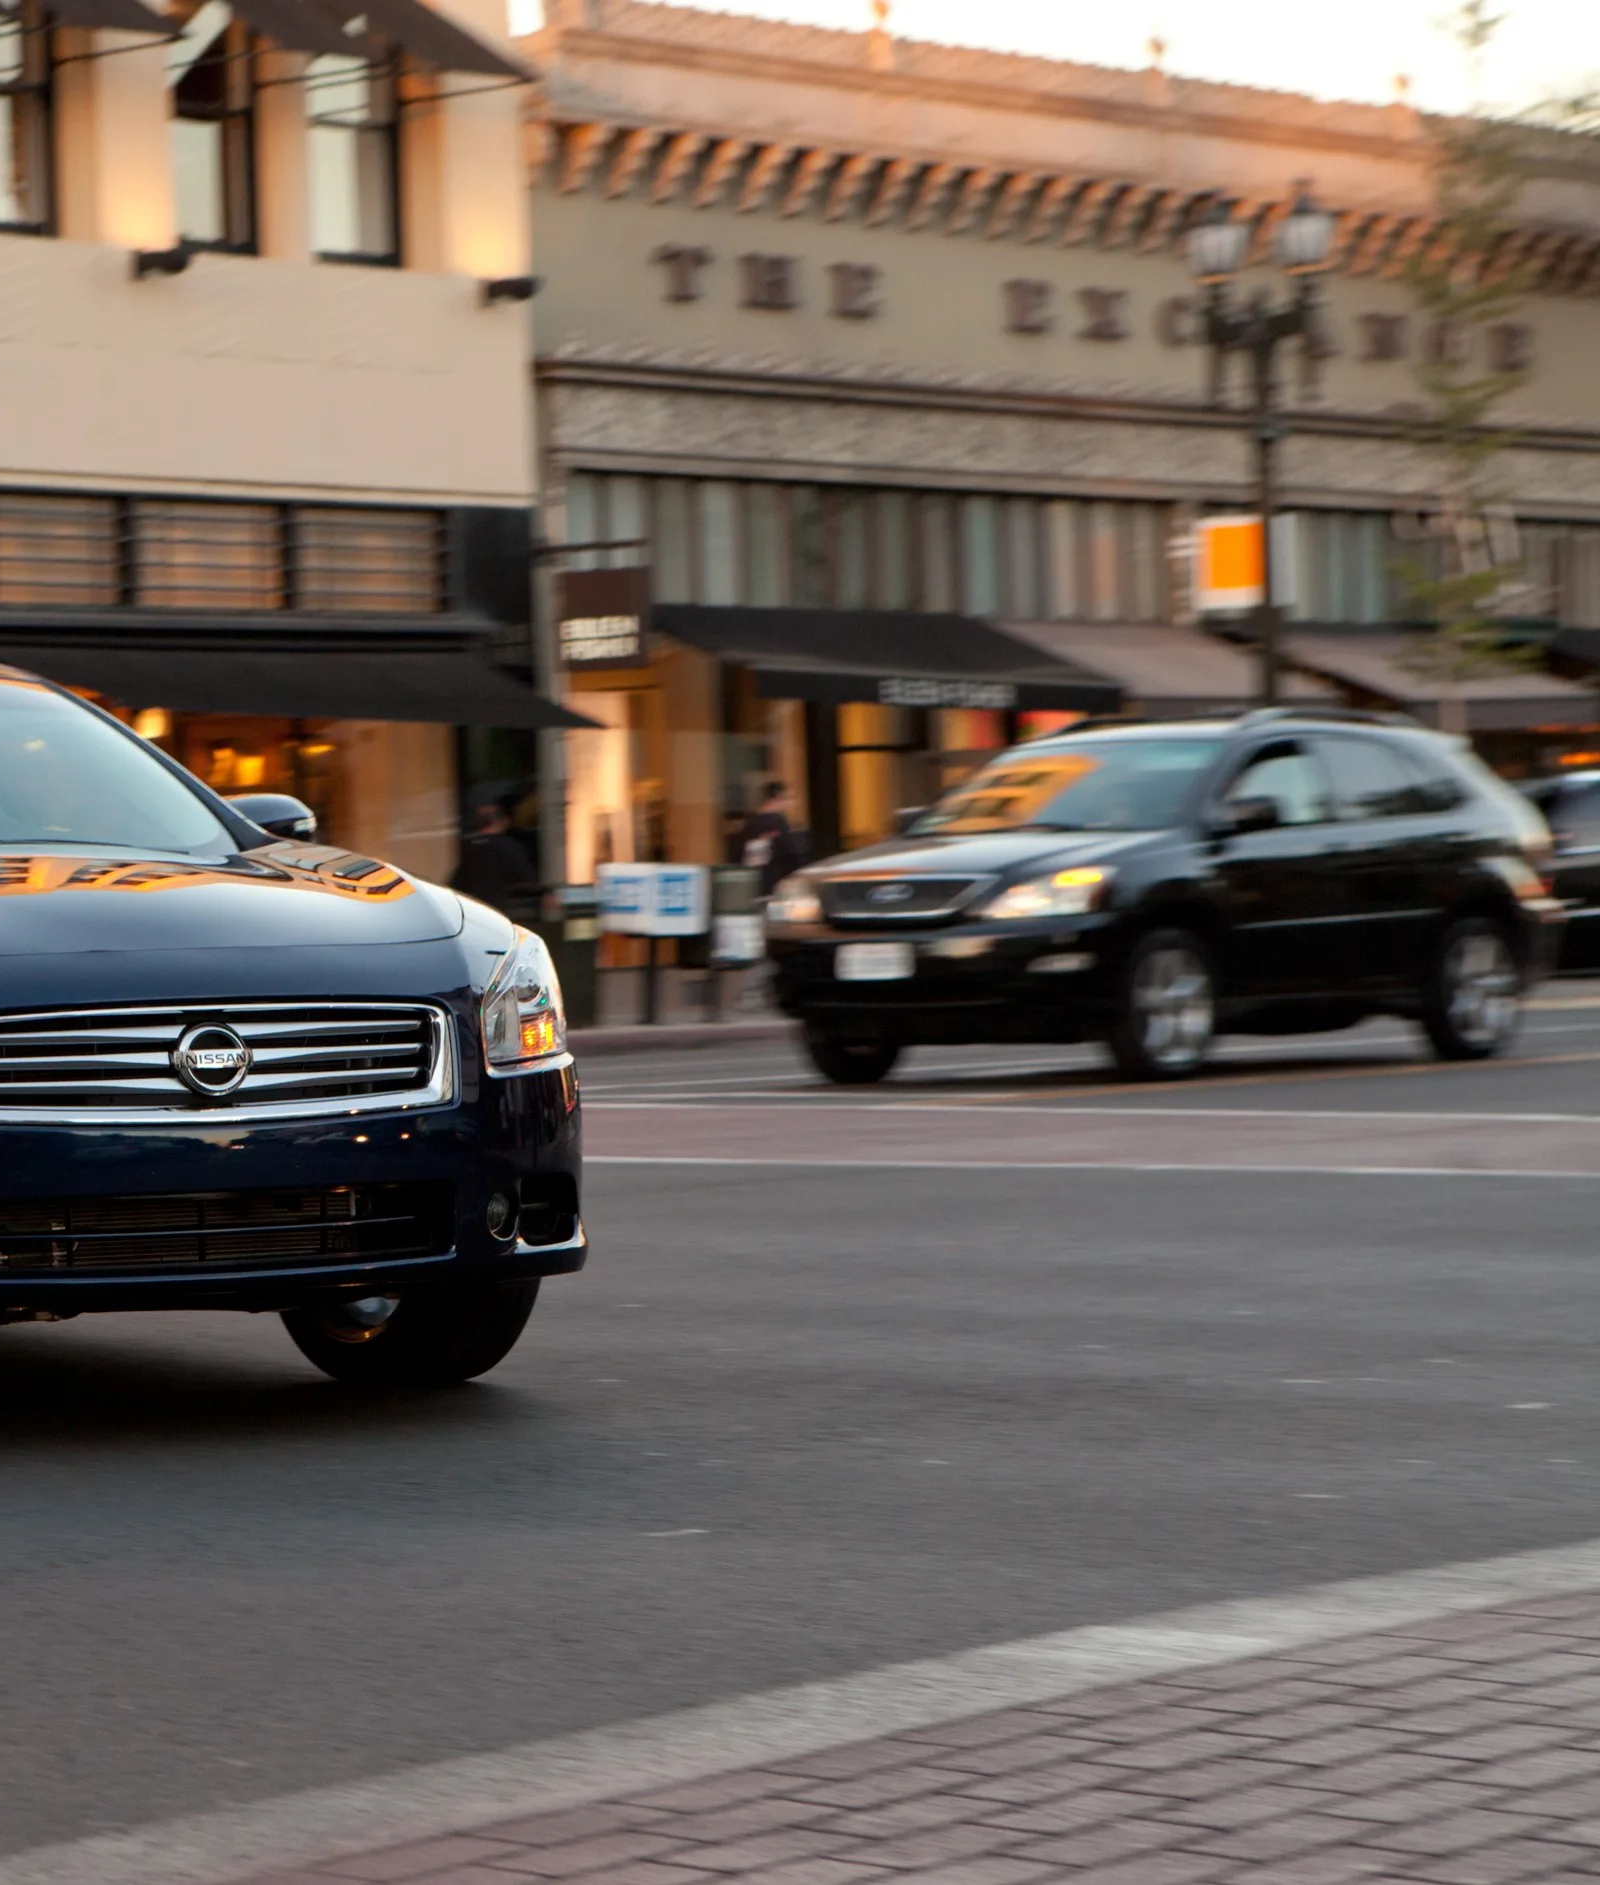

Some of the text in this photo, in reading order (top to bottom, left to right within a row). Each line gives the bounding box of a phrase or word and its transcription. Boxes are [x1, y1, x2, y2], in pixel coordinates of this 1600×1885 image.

[653, 244, 1537, 373] THE EXCNGE
[185, 1053, 247, 1066] NISSAN
